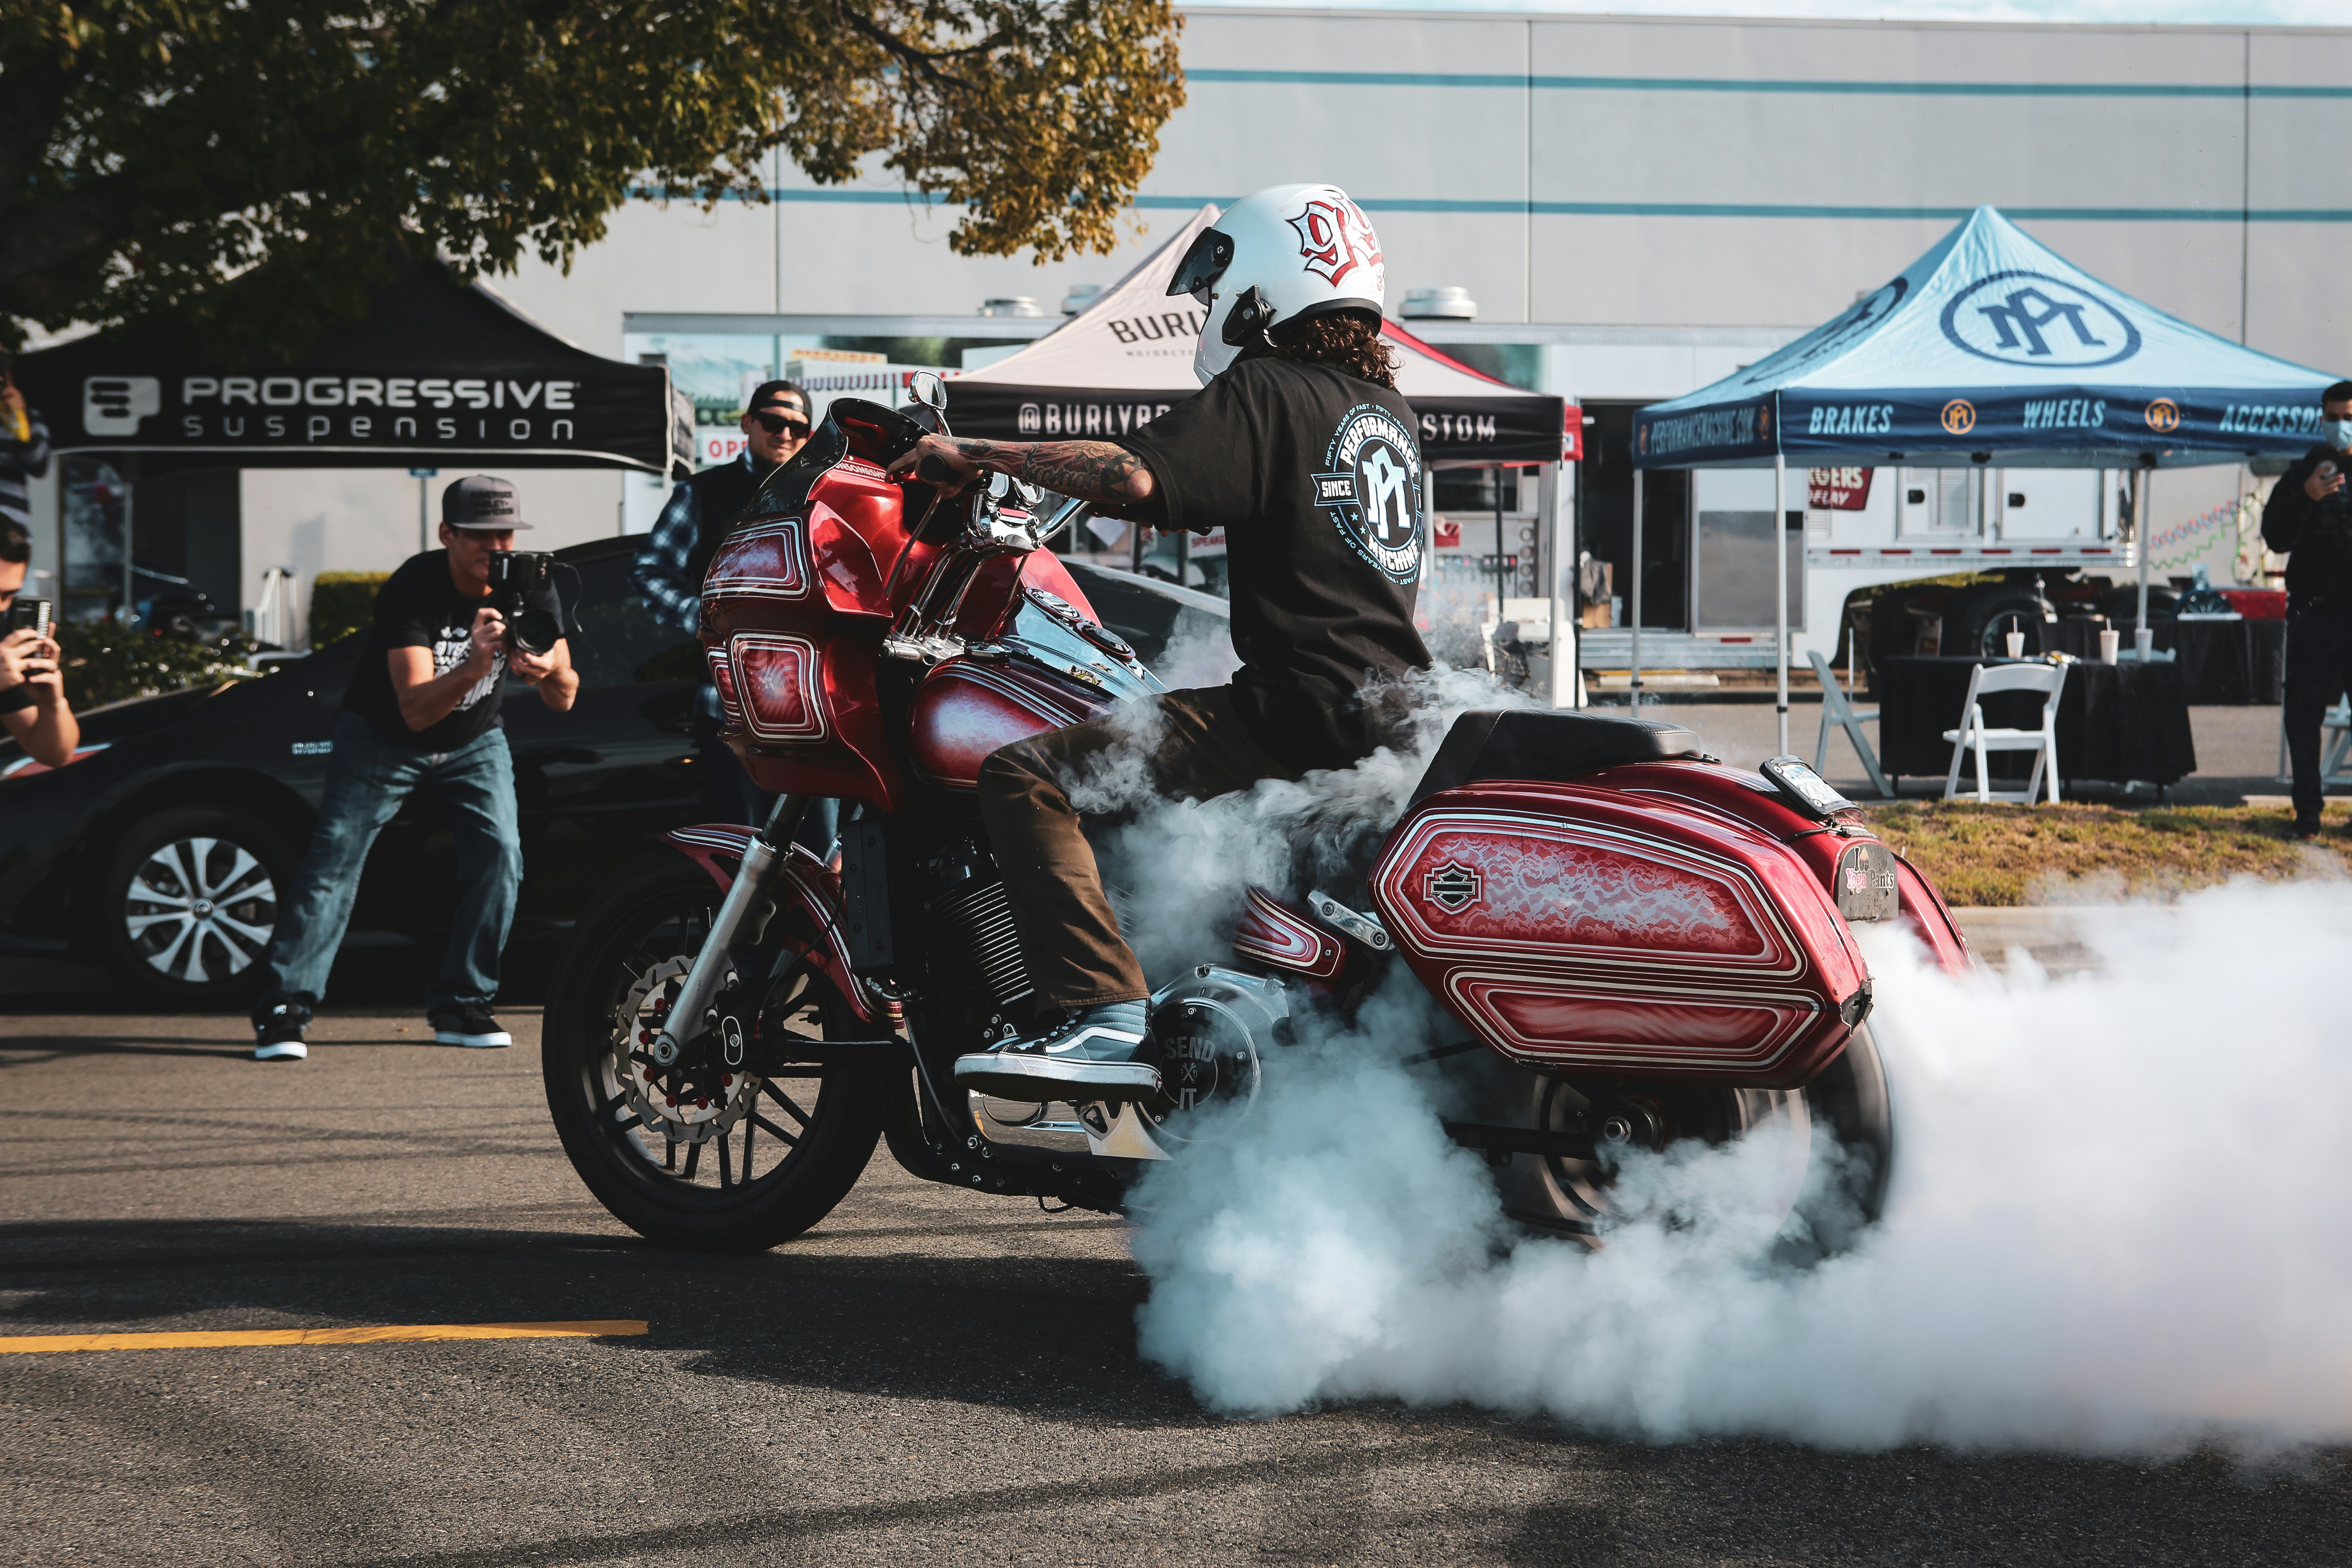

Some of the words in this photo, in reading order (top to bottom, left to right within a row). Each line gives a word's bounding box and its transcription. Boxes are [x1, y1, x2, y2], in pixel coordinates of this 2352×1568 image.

[1108, 310, 1207, 343] BURL
[183, 378, 575, 409] PROGRESSIVE
[1375, 404, 1391, 417] FIFTY
[1392, 416, 1411, 440] YEARS
[1809, 404, 1893, 434] BRAKES
[2023, 399, 2106, 428] WHEELS
[183, 415, 573, 443] suspension
[1325, 439, 1336, 466] FIFTY
[1334, 414, 1350, 437] YEARS
[1414, 414, 1496, 442] STOM
[1339, 416, 1419, 478] PERFORMANCE
[1321, 480, 1352, 497] SINCE
[1330, 512, 1346, 535] FAST
[1345, 537, 1356, 548] OF
[1368, 533, 1418, 571] MACHINE
[1357, 549, 1382, 572] YEARS
[1845, 868, 1867, 893] Yoga
[1869, 868, 1894, 889] Pants
[1164, 1036, 1215, 1062] SEND
[1179, 1088, 1197, 1111] IT
